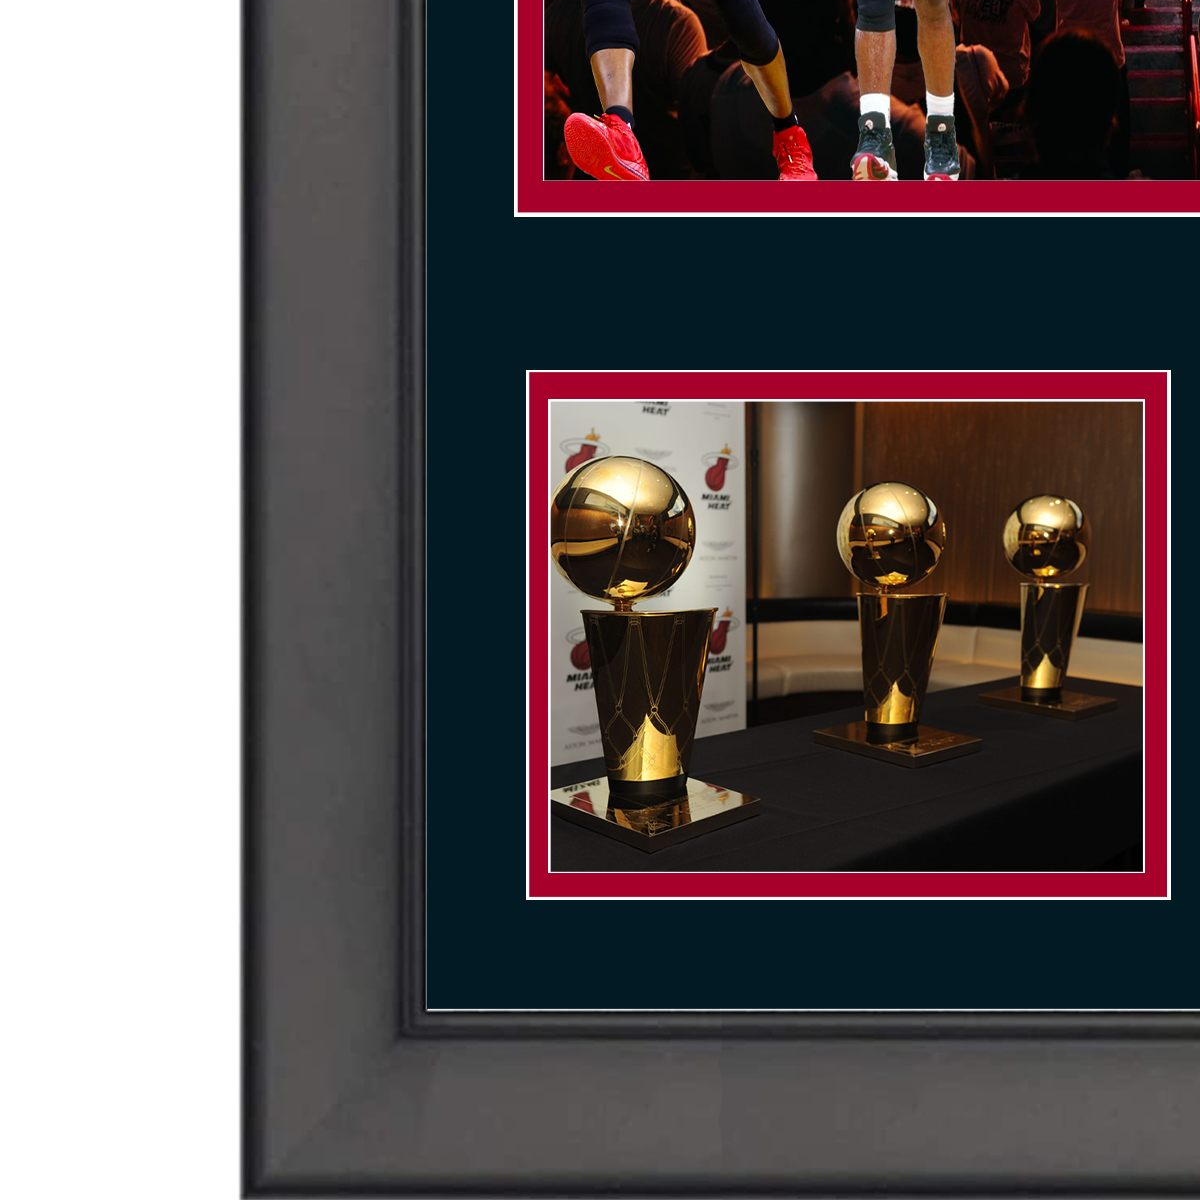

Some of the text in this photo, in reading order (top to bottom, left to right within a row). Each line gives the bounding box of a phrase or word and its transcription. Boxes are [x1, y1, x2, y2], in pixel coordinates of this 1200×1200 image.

[642, 405, 671, 416] HEAT
[708, 501, 732, 510] HEAT
[709, 662, 735, 673] HEAT
